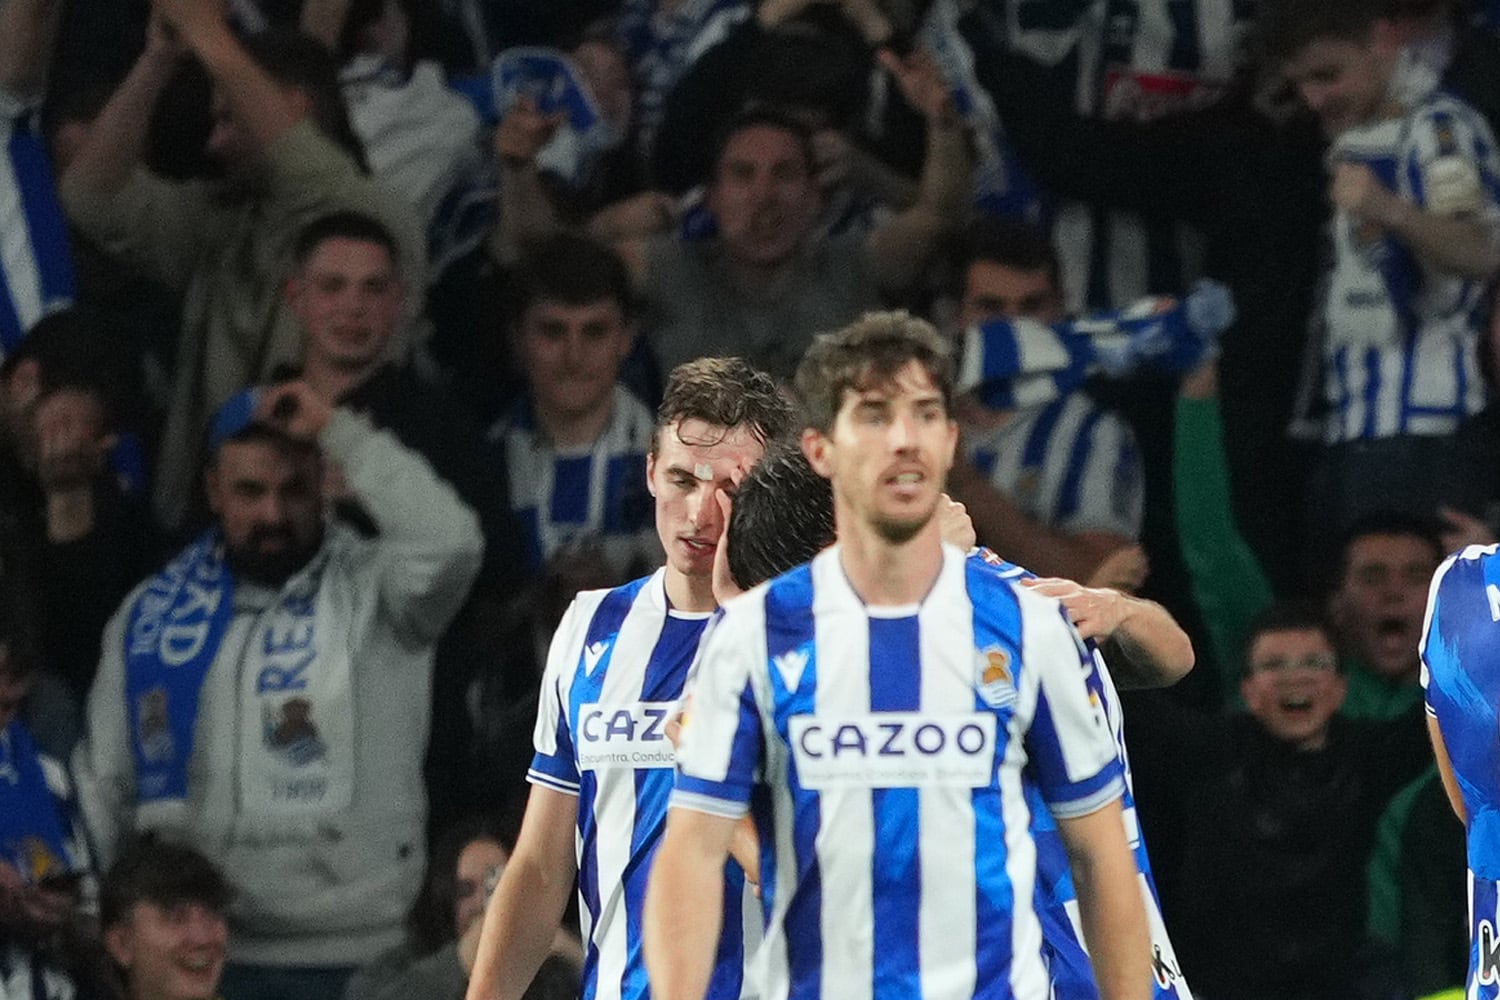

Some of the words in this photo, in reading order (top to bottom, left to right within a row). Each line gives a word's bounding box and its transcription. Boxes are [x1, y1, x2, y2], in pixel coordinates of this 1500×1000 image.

[583, 708, 667, 742] CAZ
[800, 724, 985, 758] CAZOO
[632, 751, 675, 762] Conduc
